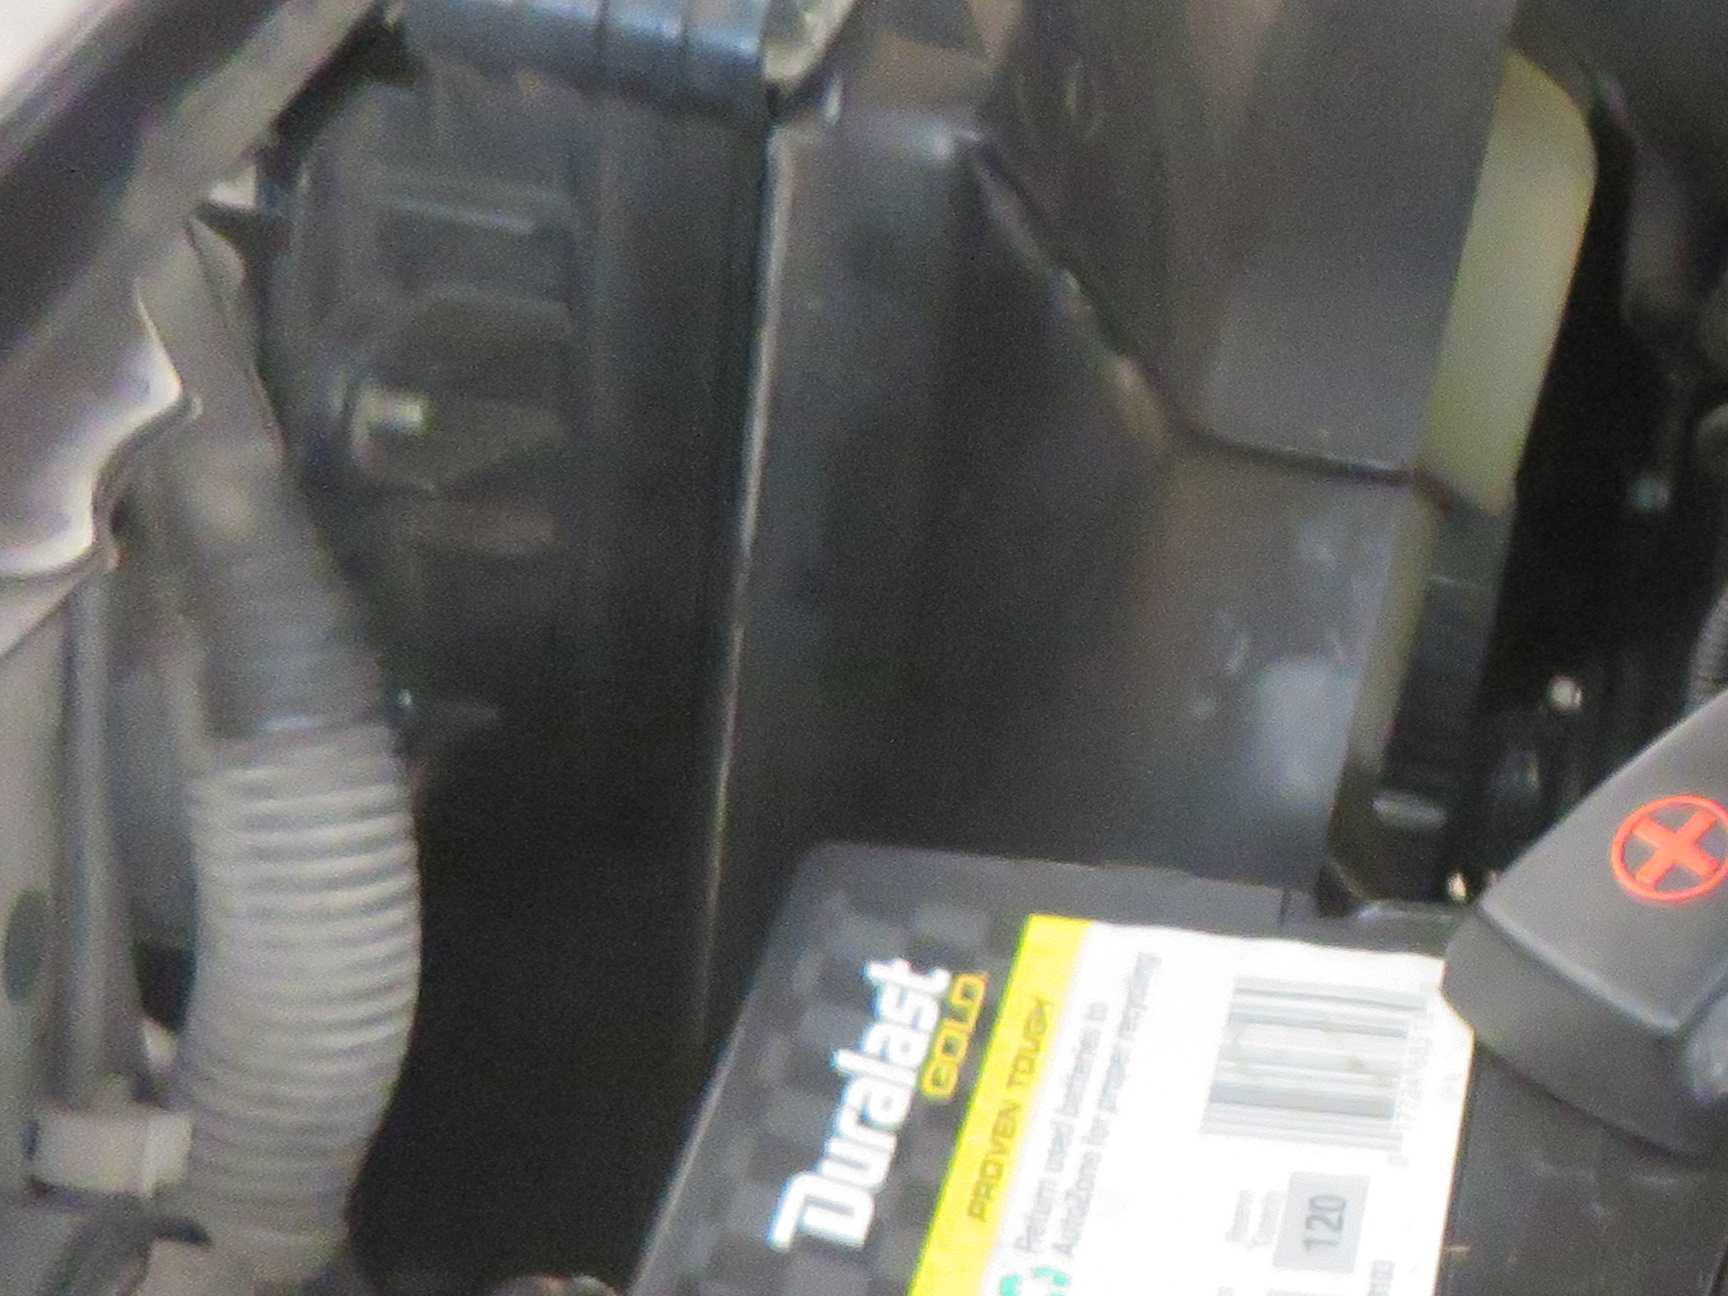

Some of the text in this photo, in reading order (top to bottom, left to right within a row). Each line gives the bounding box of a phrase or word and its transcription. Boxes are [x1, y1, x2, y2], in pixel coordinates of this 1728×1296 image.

[763, 957, 954, 1257] Duralast
[917, 971, 992, 1097] GOLD
[964, 993, 1056, 1222] PROVEN TOUGH
[1297, 1192, 1349, 1254] 120
